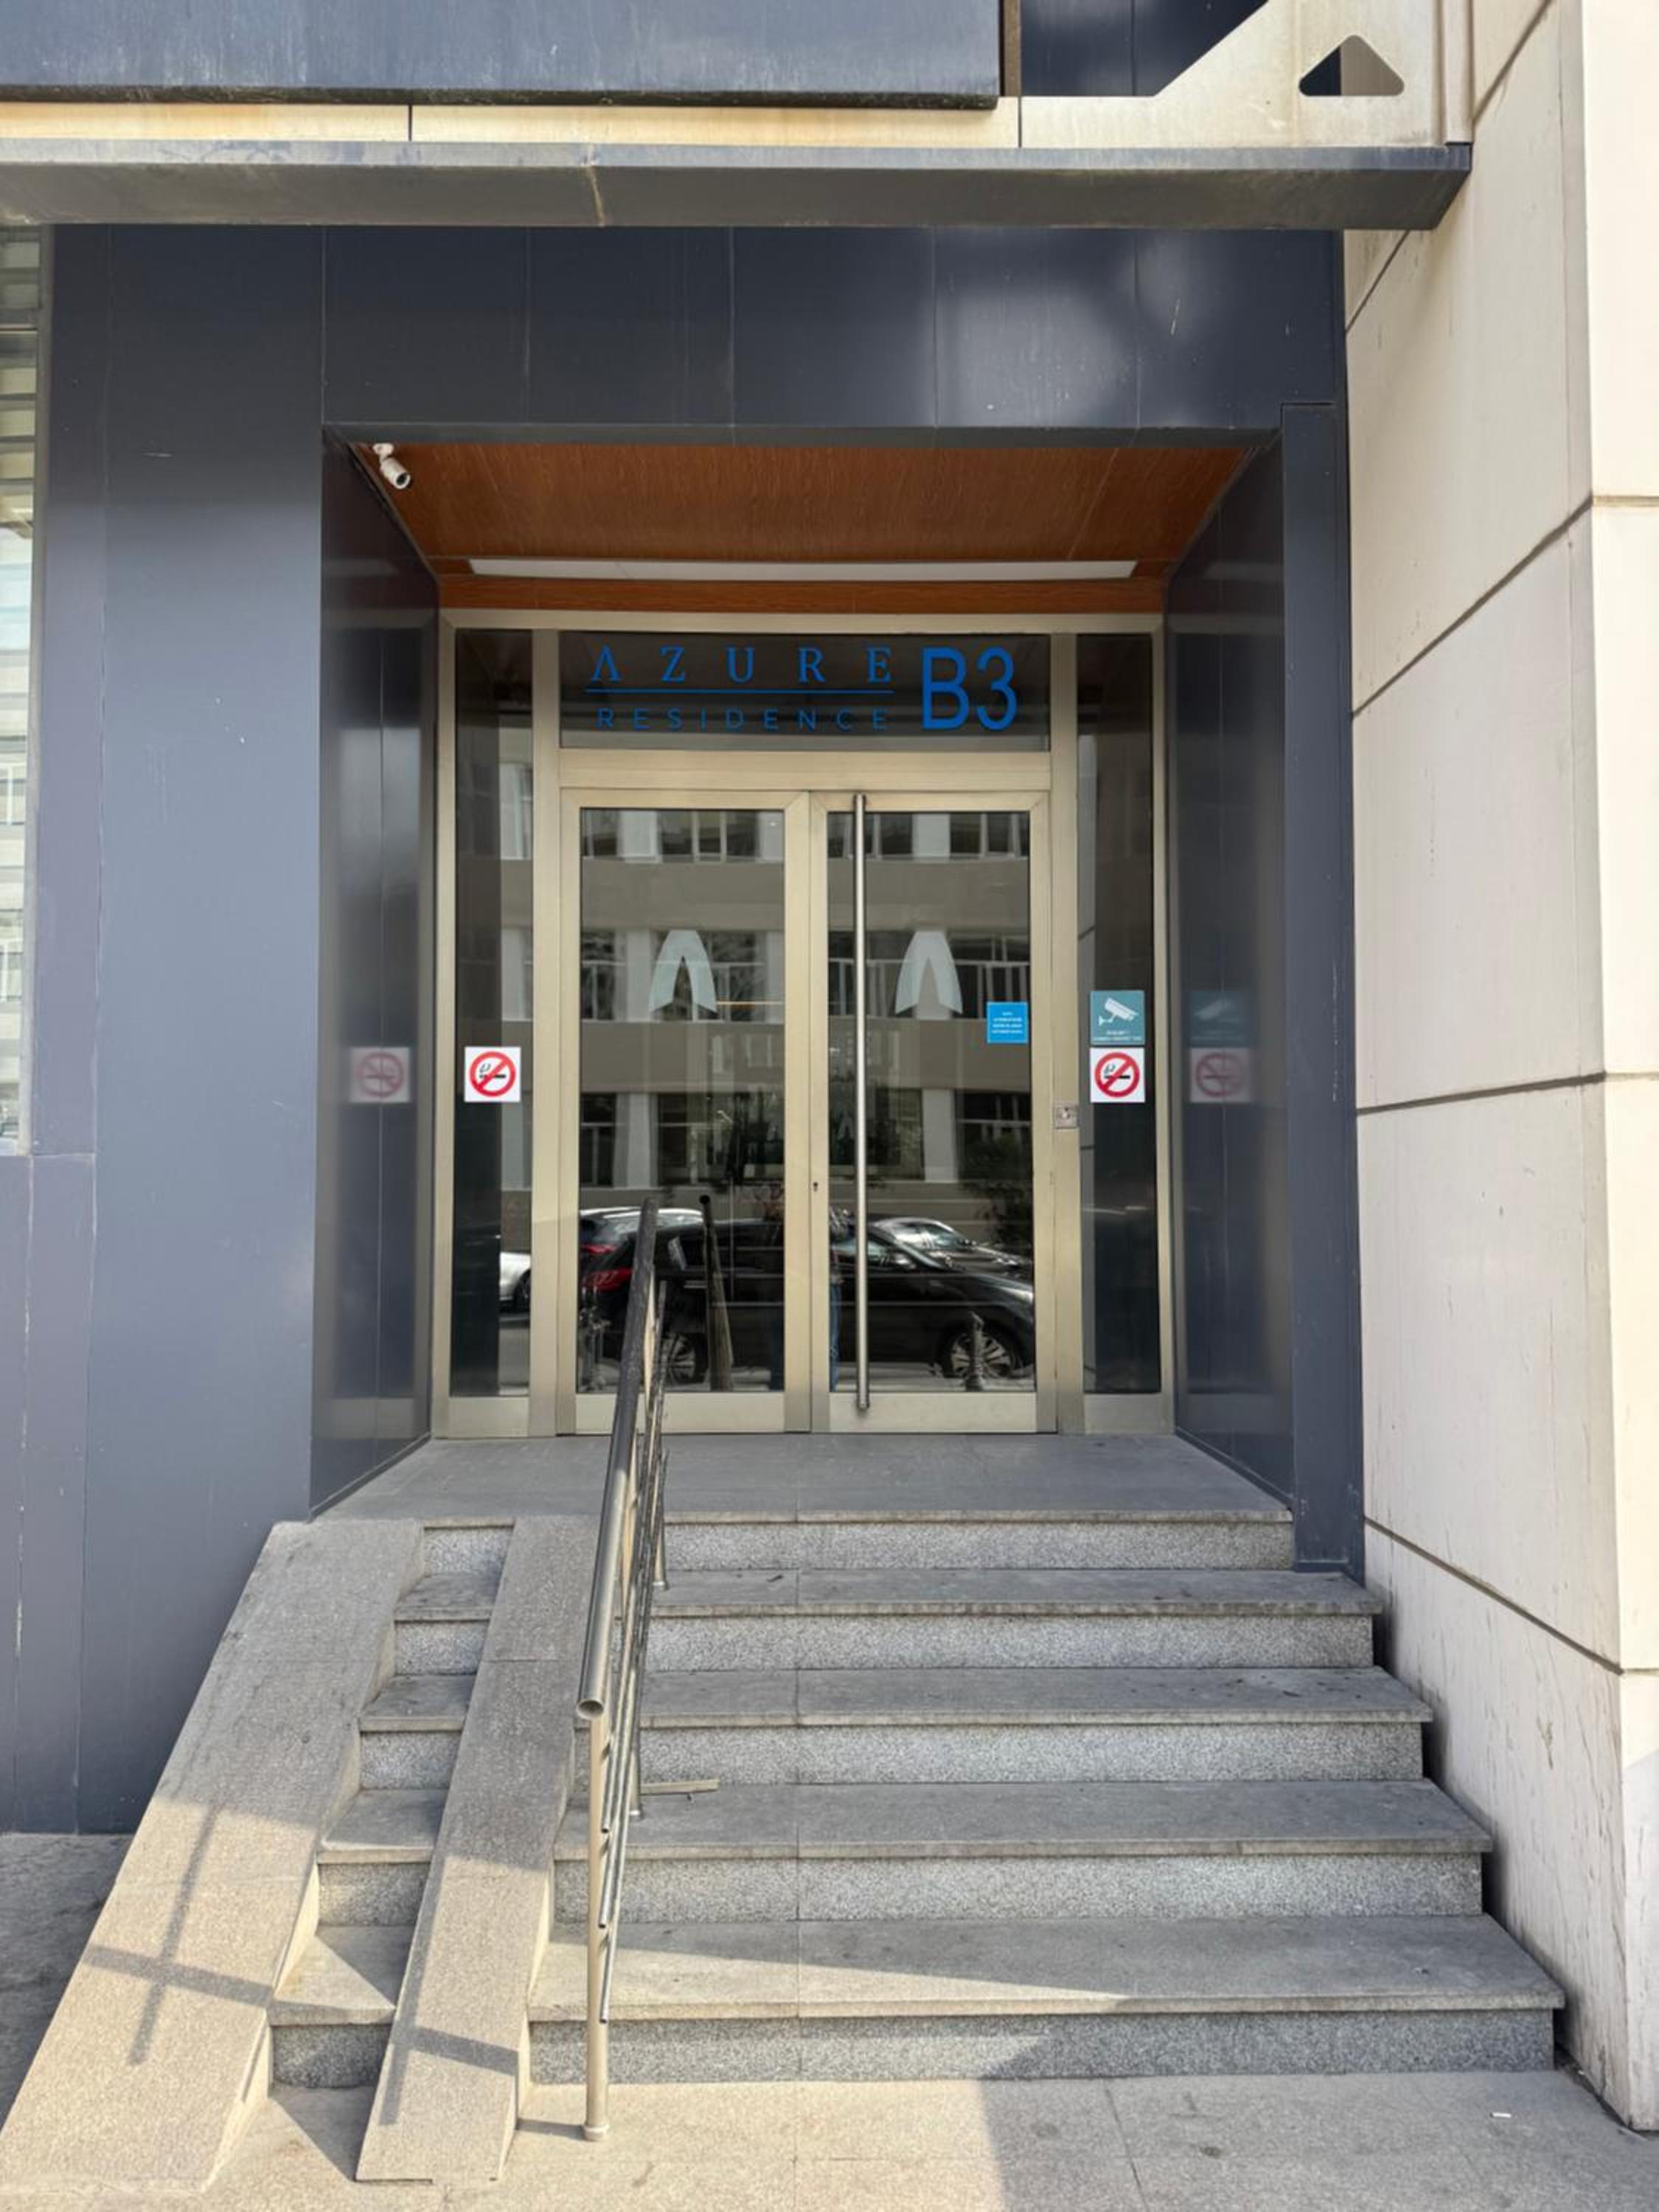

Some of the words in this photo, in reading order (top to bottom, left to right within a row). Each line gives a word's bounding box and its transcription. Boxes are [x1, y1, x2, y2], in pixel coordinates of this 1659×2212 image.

[591, 644, 893, 684] AZURE
[920, 646, 1018, 731] B3
[595, 706, 887, 731] RESIDENCE
